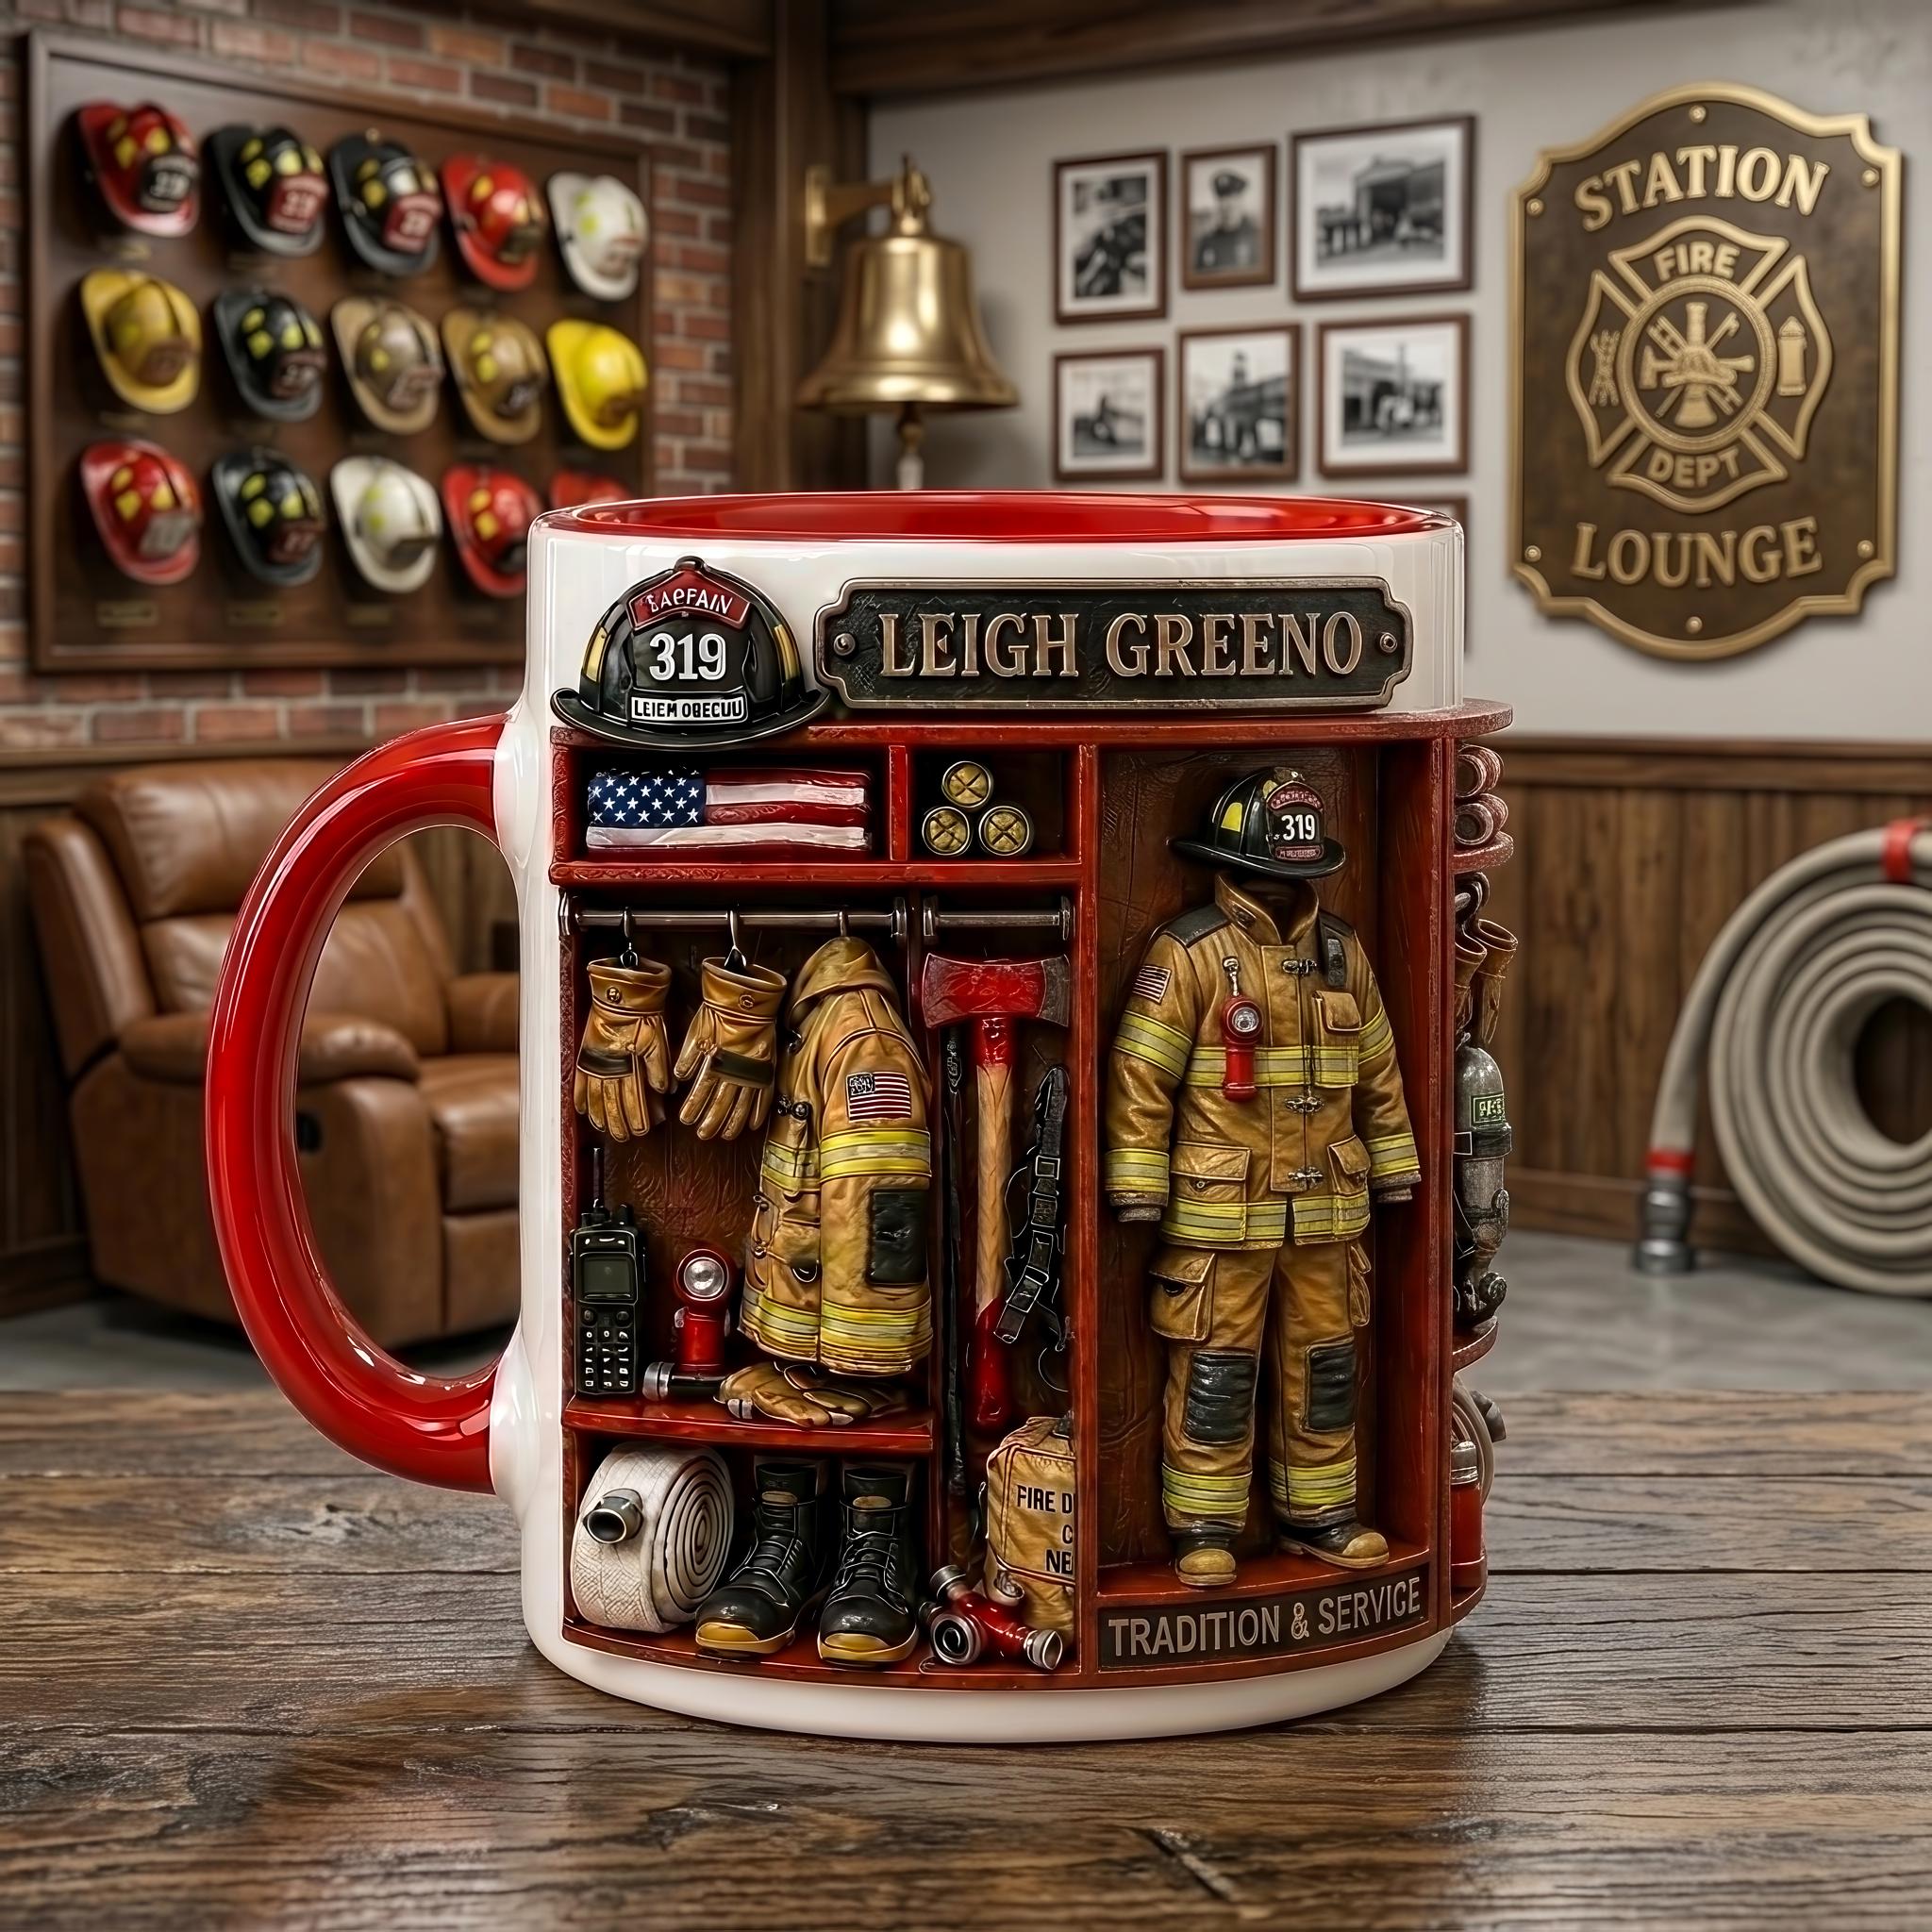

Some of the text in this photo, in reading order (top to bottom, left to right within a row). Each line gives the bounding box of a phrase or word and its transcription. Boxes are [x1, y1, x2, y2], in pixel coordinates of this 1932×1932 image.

[1574, 144, 1830, 232] STATION
[1654, 241, 1740, 281] FIRE
[1646, 450, 1740, 489] DEPT
[1571, 515, 1824, 588] LOUNGE
[648, 632, 726, 681] 319
[877, 610, 1364, 677] LEIGH GREENO
[1281, 813, 1316, 841] 319
[1017, 1485, 1075, 1515] FIRE D
[1108, 1576, 1422, 1657] TRADITION & SERVICE
